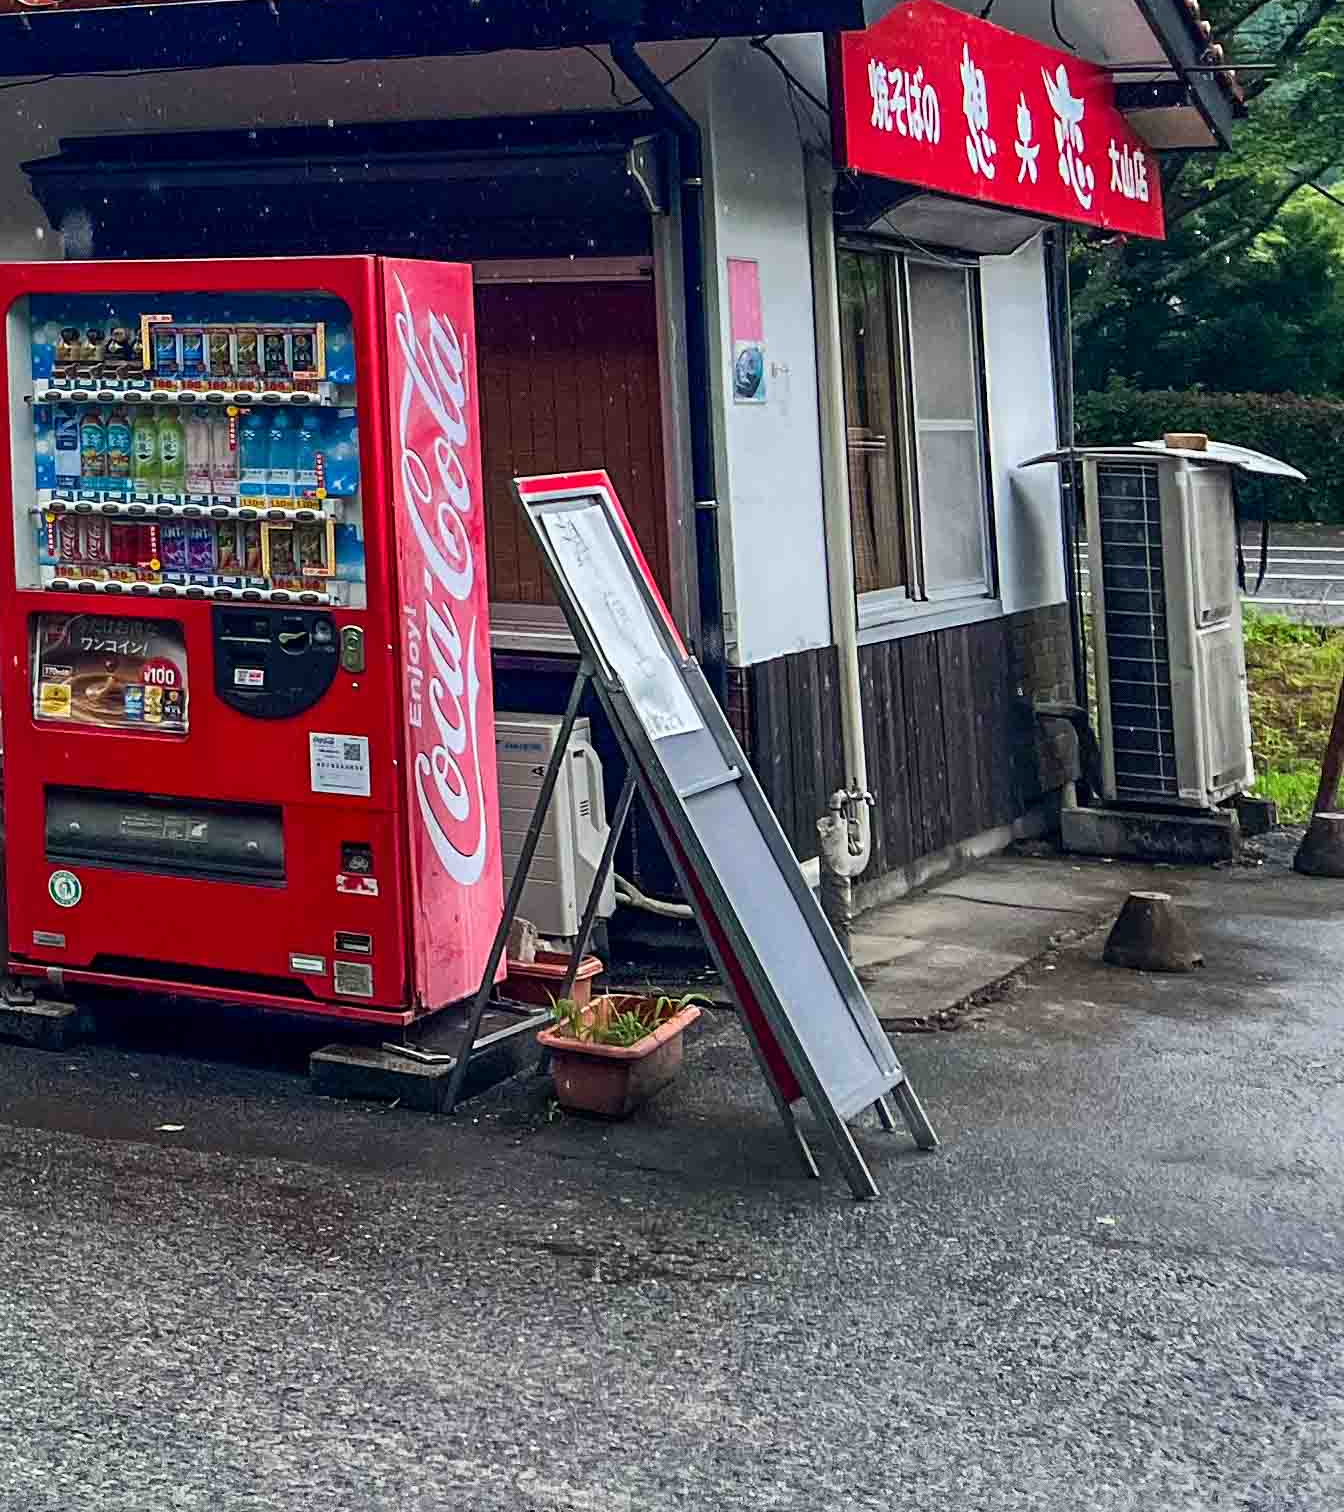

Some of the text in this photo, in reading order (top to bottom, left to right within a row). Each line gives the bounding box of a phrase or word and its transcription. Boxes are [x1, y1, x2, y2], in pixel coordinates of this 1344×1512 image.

[867, 57, 941, 145] 焼そばの
[1108, 137, 1150, 203] 大山店
[393, 271, 487, 886] Coca-Cola
